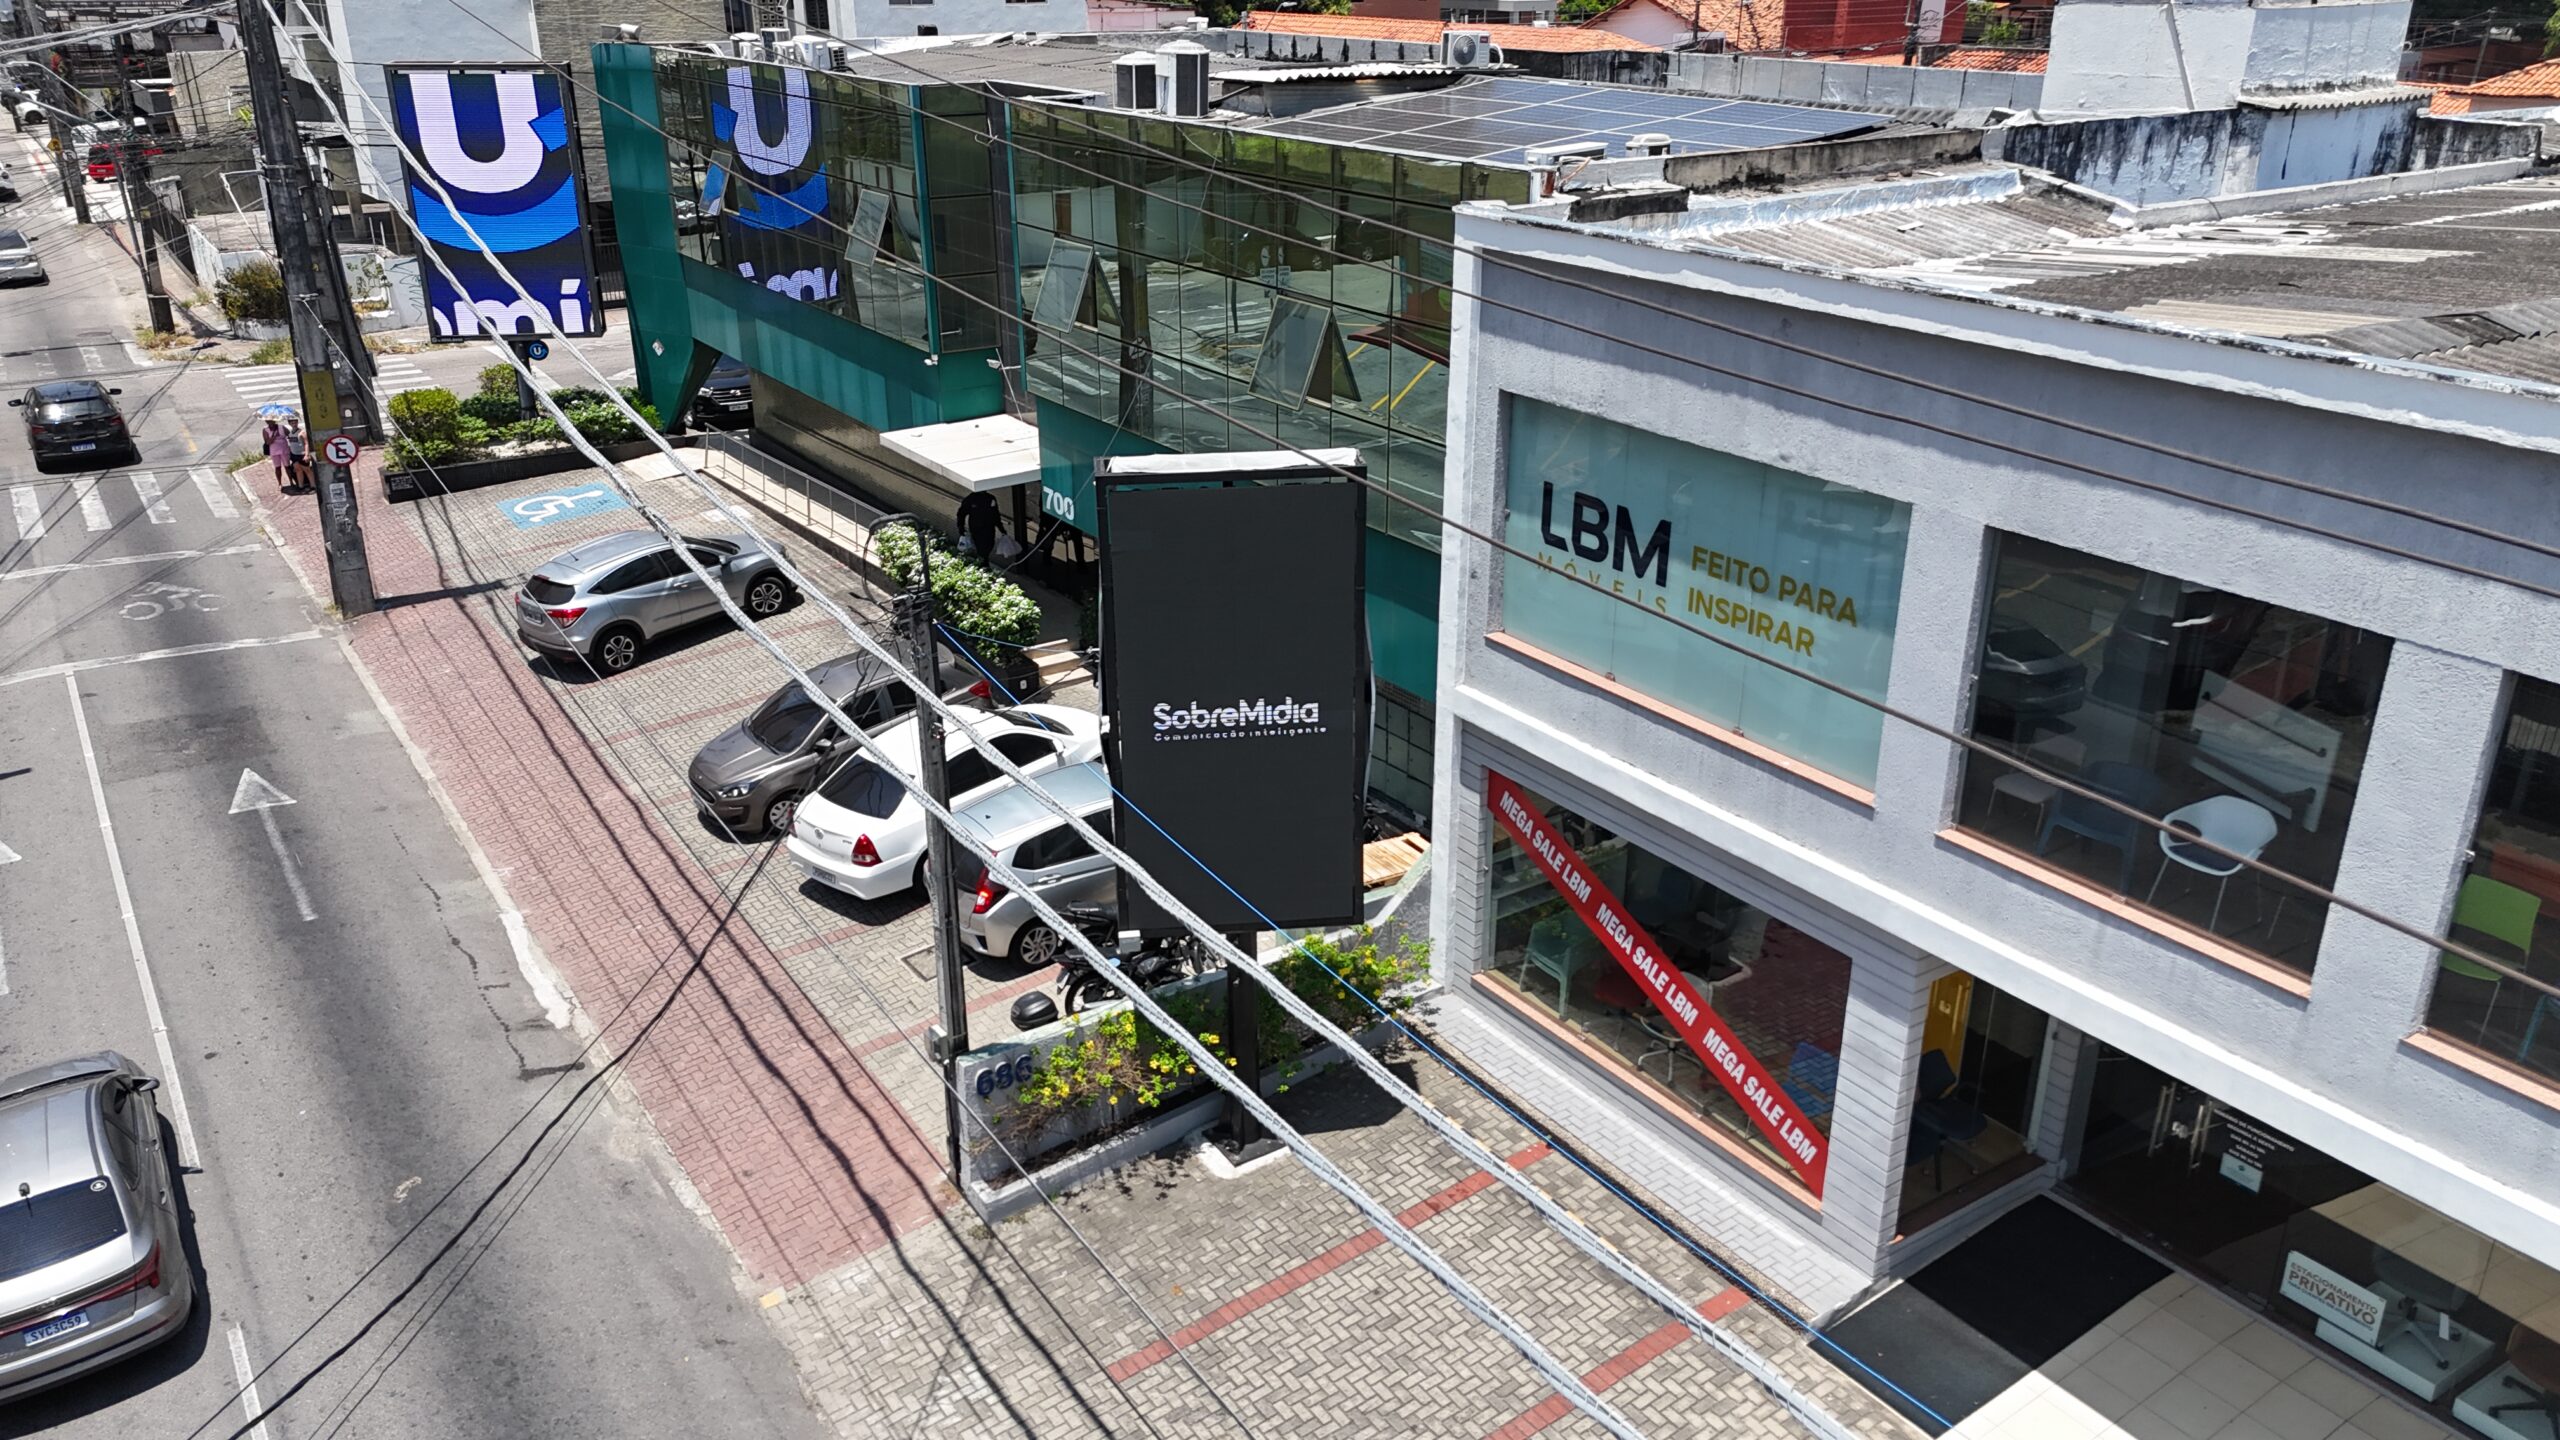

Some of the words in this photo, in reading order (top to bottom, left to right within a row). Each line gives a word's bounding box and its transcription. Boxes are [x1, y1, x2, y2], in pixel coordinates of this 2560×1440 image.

[335, 442, 348, 459] E
[1042, 485, 1075, 521] 700
[1541, 481, 1672, 588] LBM
[1691, 545, 1770, 594] FEITO
[1778, 575, 1857, 628] PARA
[1687, 587, 1815, 657] INSPIRAR
[1500, 790, 1534, 839] MEGA
[1532, 830, 1566, 873] SALE
[1562, 863, 1592, 904] LBM
[1596, 902, 1634, 955] MEGA
[1632, 946, 1670, 993] SALE
[1664, 983, 1699, 1027] LBM
[1702, 1027, 1746, 1085] MEGA
[1743, 1076, 1785, 1127] SALE
[1779, 1118, 1818, 1165] LBM
[2288, 1270, 2375, 1326] PRIVATIVO
[2290, 1262, 2378, 1315] ESTACIONAMENTO
